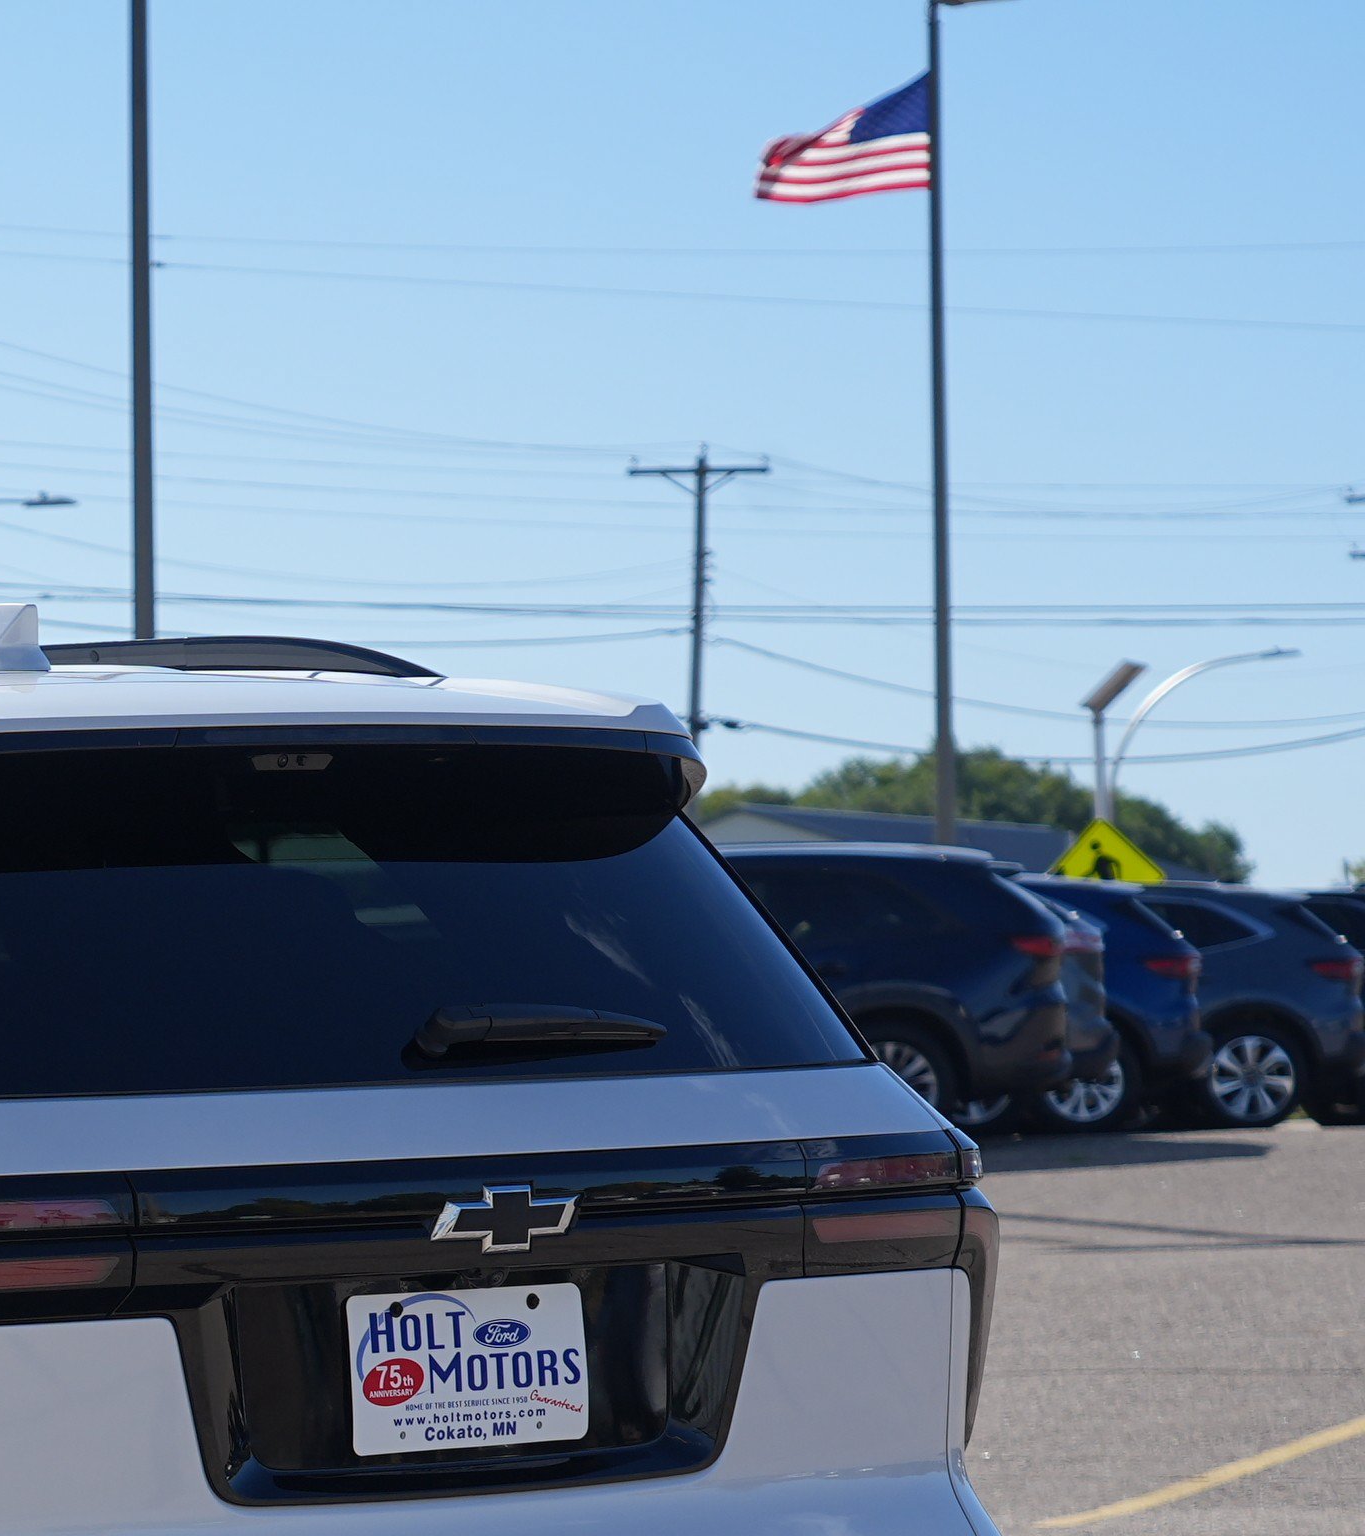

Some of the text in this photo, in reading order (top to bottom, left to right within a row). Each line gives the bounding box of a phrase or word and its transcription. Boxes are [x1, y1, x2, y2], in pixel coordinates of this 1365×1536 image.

[369, 1311, 466, 1353] HOLT
[484, 1324, 519, 1343] Ford
[376, 1365, 414, 1389] 75th
[429, 1348, 581, 1394] MOTORS
[369, 1388, 414, 1398] ANNIVERSARY
[530, 1389, 583, 1413] Guaranteed
[405, 1396, 528, 1412] HOME OF THE BEST SERVICE SINCE 1950
[394, 1407, 546, 1426] www.holtmotors.com
[425, 1421, 517, 1441] Cokato, MN
